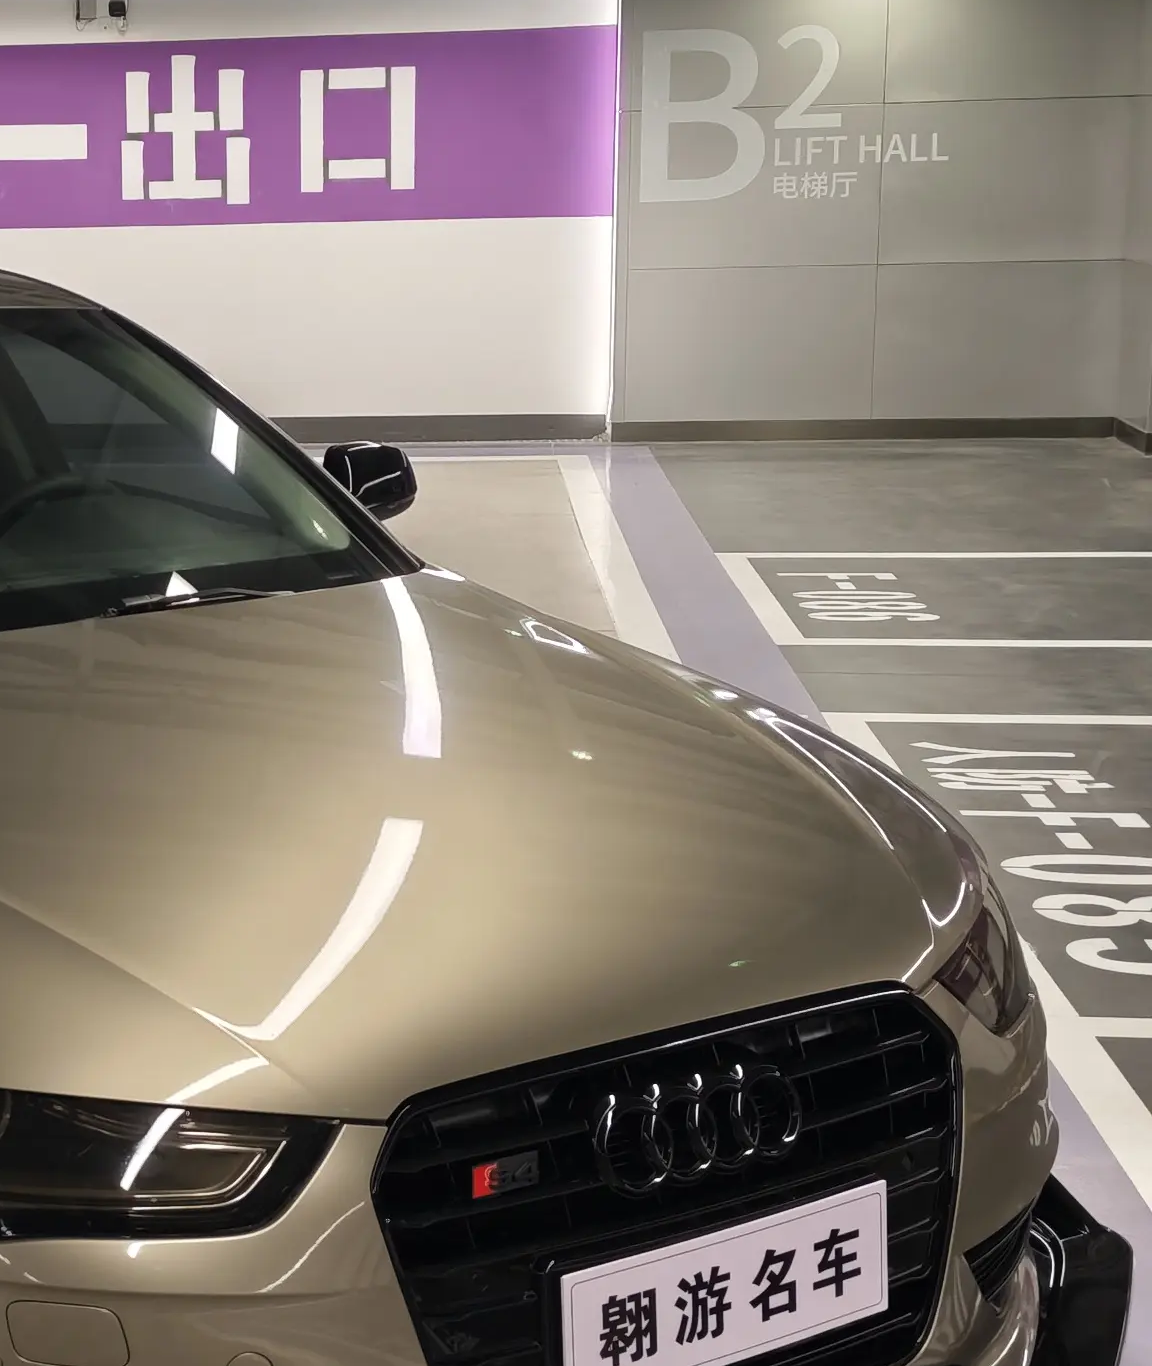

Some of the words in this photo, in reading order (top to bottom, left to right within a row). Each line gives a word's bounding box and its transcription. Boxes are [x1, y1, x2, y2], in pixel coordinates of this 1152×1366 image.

[121, 55, 416, 205] 出口
[640, 24, 843, 203] B2
[773, 135, 847, 166] LIFT
[859, 132, 949, 163] HALL
[773, 171, 858, 199] 电梯厅
[776, 572, 941, 622] F-086
